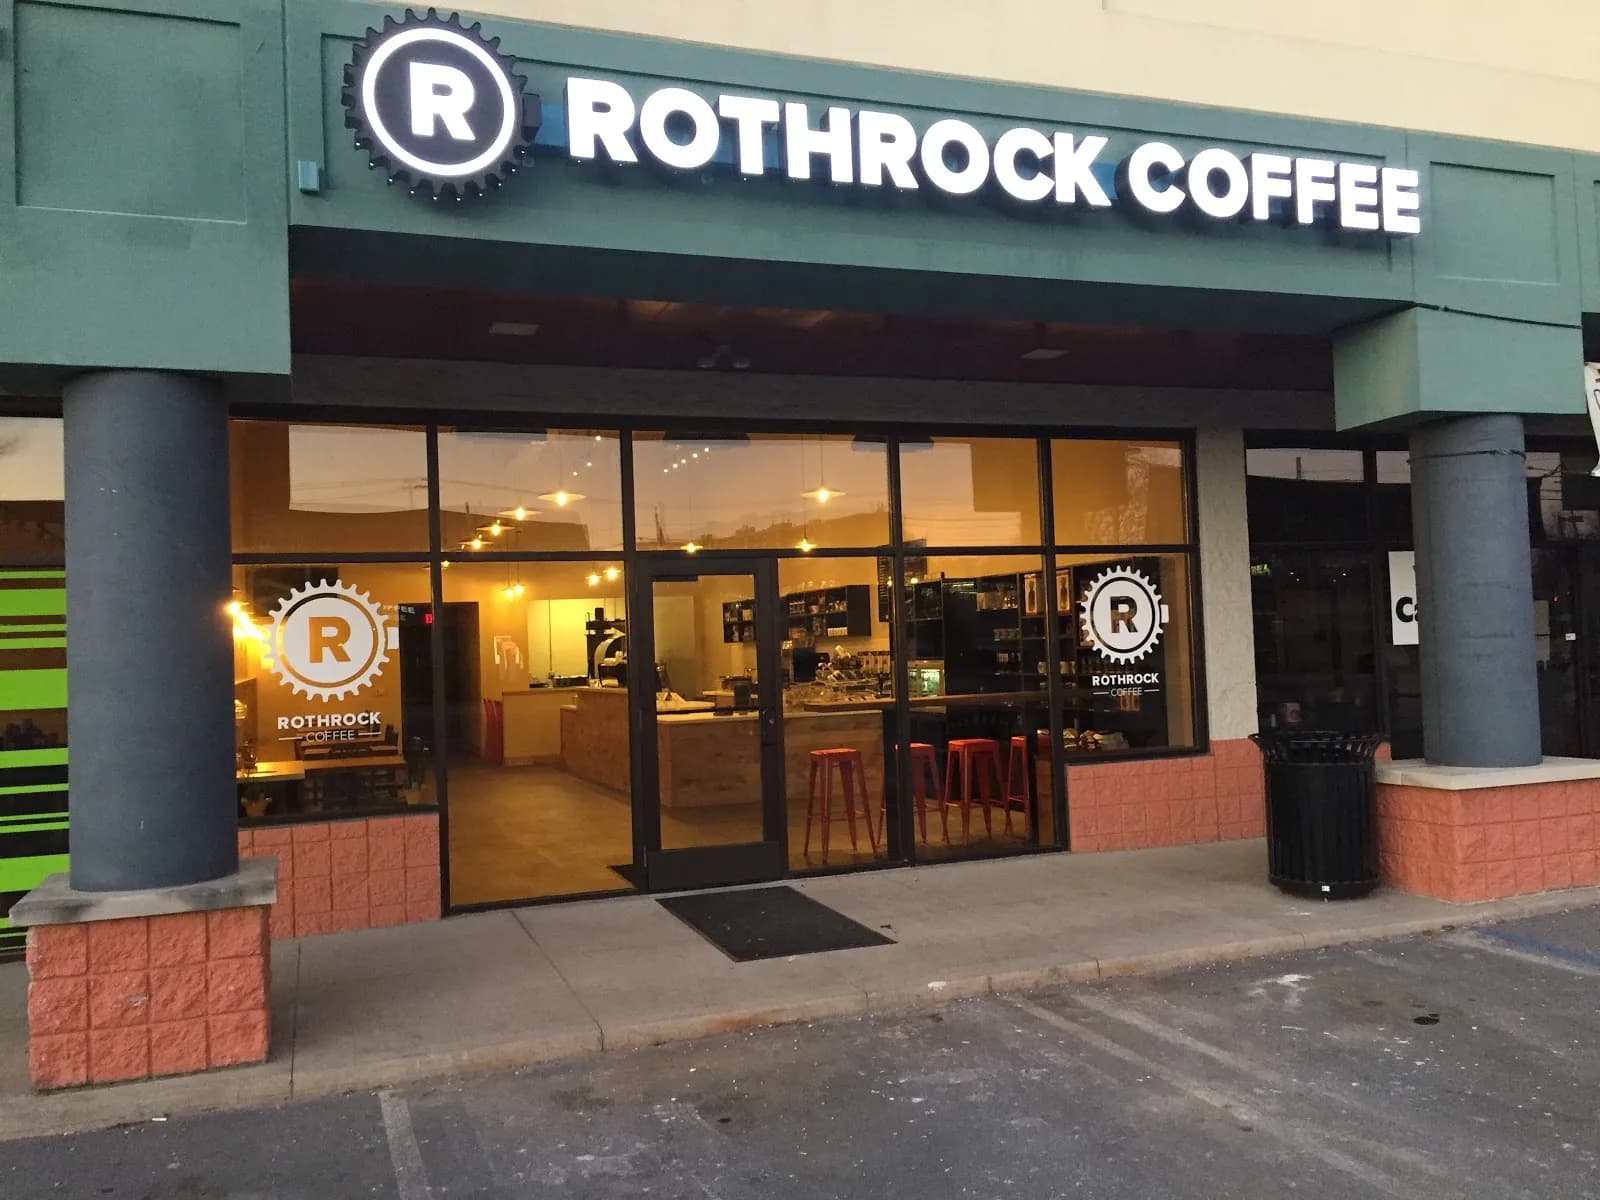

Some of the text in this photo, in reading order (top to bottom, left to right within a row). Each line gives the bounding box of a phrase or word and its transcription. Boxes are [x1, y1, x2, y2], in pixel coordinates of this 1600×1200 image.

[408, 61, 476, 141] R
[566, 76, 1421, 234] ROTHROCK COFFEE
[1109, 595, 1138, 633] R
[308, 616, 351, 663] R
[1091, 672, 1159, 686] ROTHROCK
[1110, 686, 1142, 697] COFFEE
[277, 711, 381, 729] ROTHROCK
[305, 729, 355, 742] COFFEE
